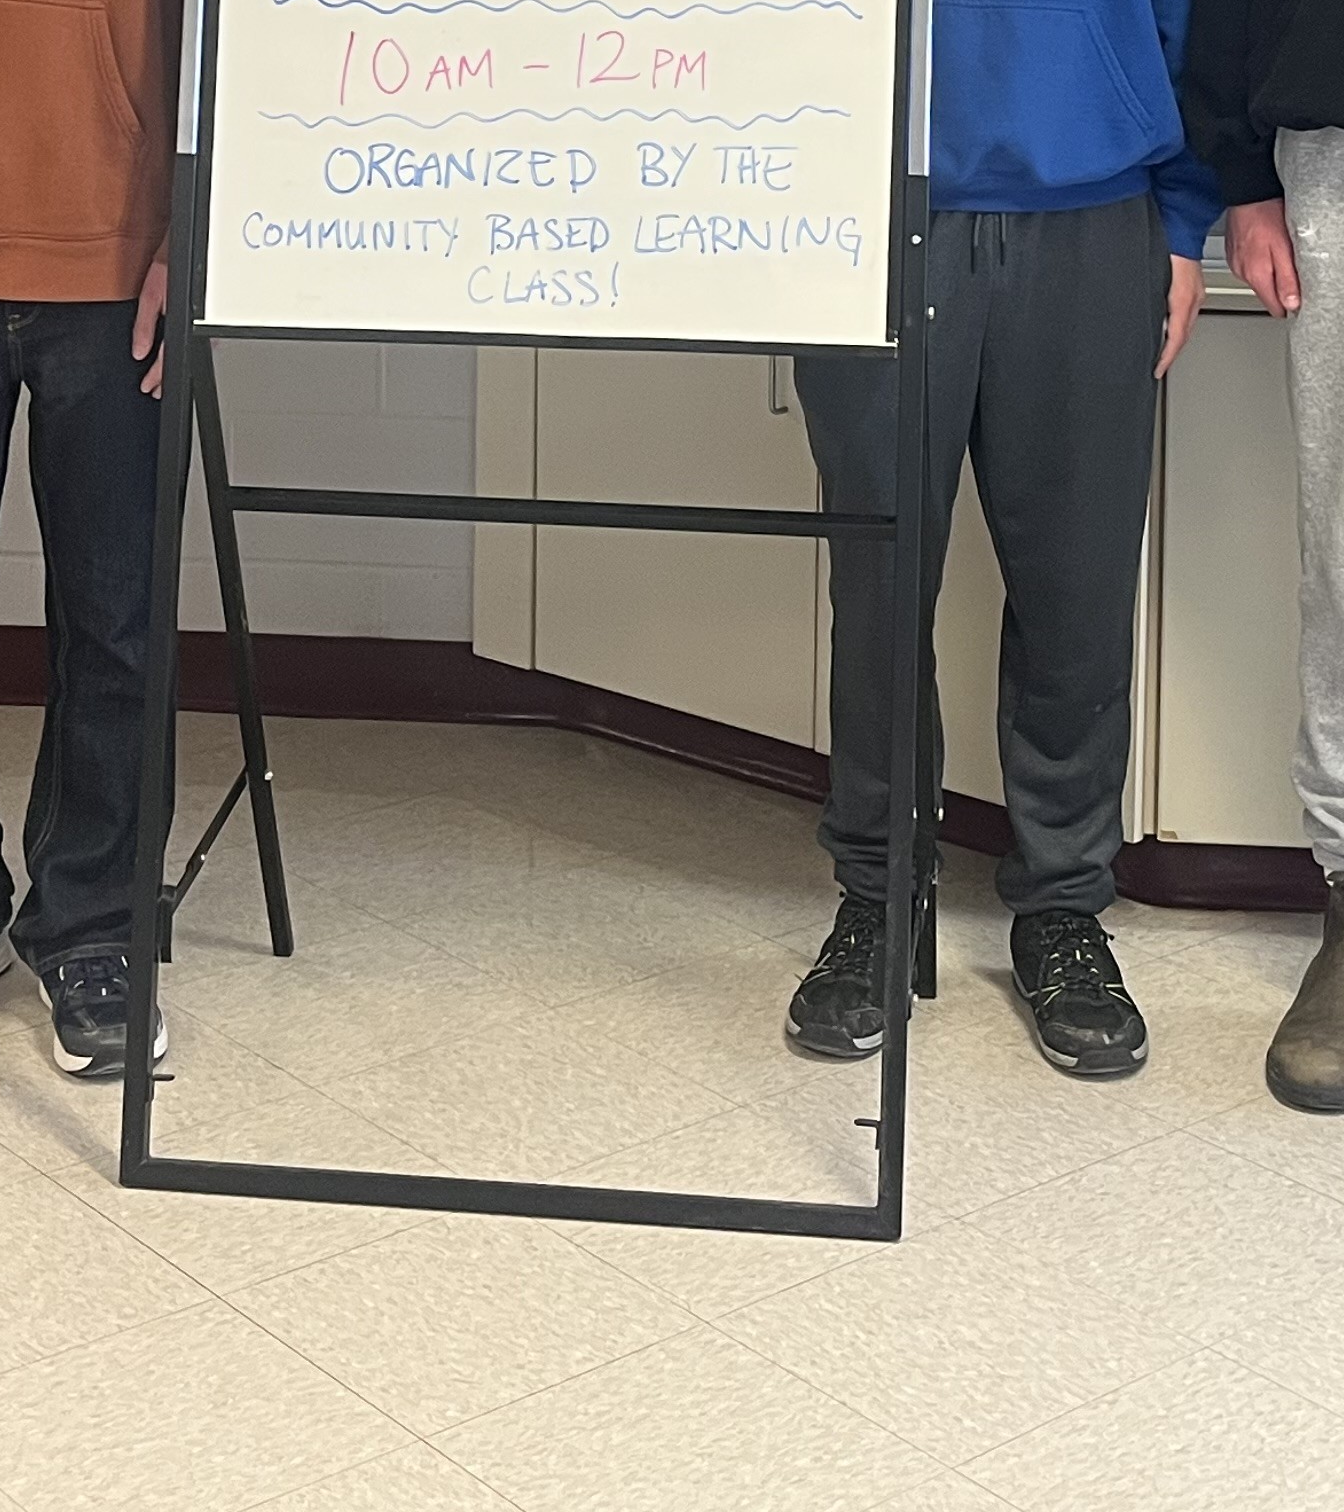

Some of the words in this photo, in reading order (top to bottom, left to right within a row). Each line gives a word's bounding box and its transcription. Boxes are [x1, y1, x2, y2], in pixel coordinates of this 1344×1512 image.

[324, 142, 597, 194] ORGANIZED
[637, 141, 697, 188] BY
[712, 145, 799, 191] THE
[242, 211, 459, 257] COMMUNITY
[485, 213, 610, 255] BASED
[634, 214, 863, 266] LEARNING
[467, 261, 620, 308] CLASS!
